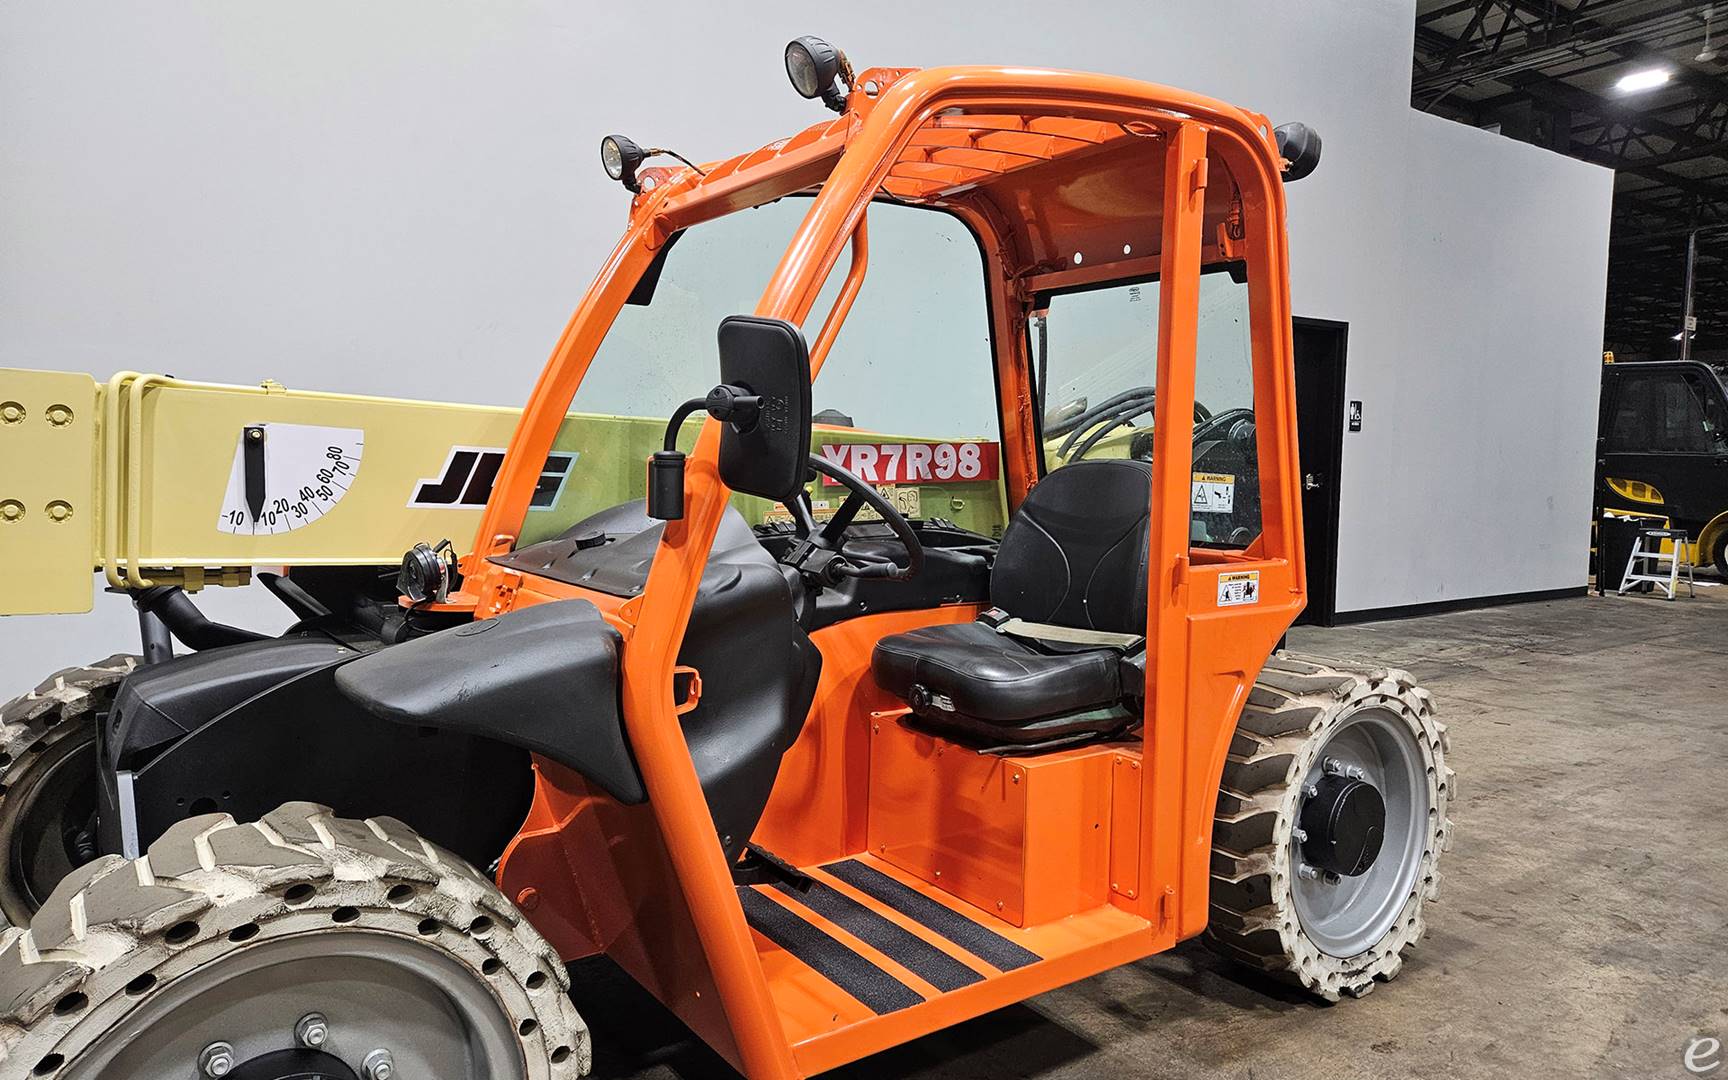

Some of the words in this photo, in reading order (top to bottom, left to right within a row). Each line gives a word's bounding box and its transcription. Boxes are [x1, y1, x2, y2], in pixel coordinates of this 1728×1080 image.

[326, 446, 343, 460] 80
[316, 468, 334, 484] 60
[331, 461, 350, 476] 70
[299, 486, 315, 502] 40
[315, 485, 334, 501] 50
[273, 498, 290, 514] 20
[291, 502, 308, 518] 30
[261, 512, 276, 526] 10
